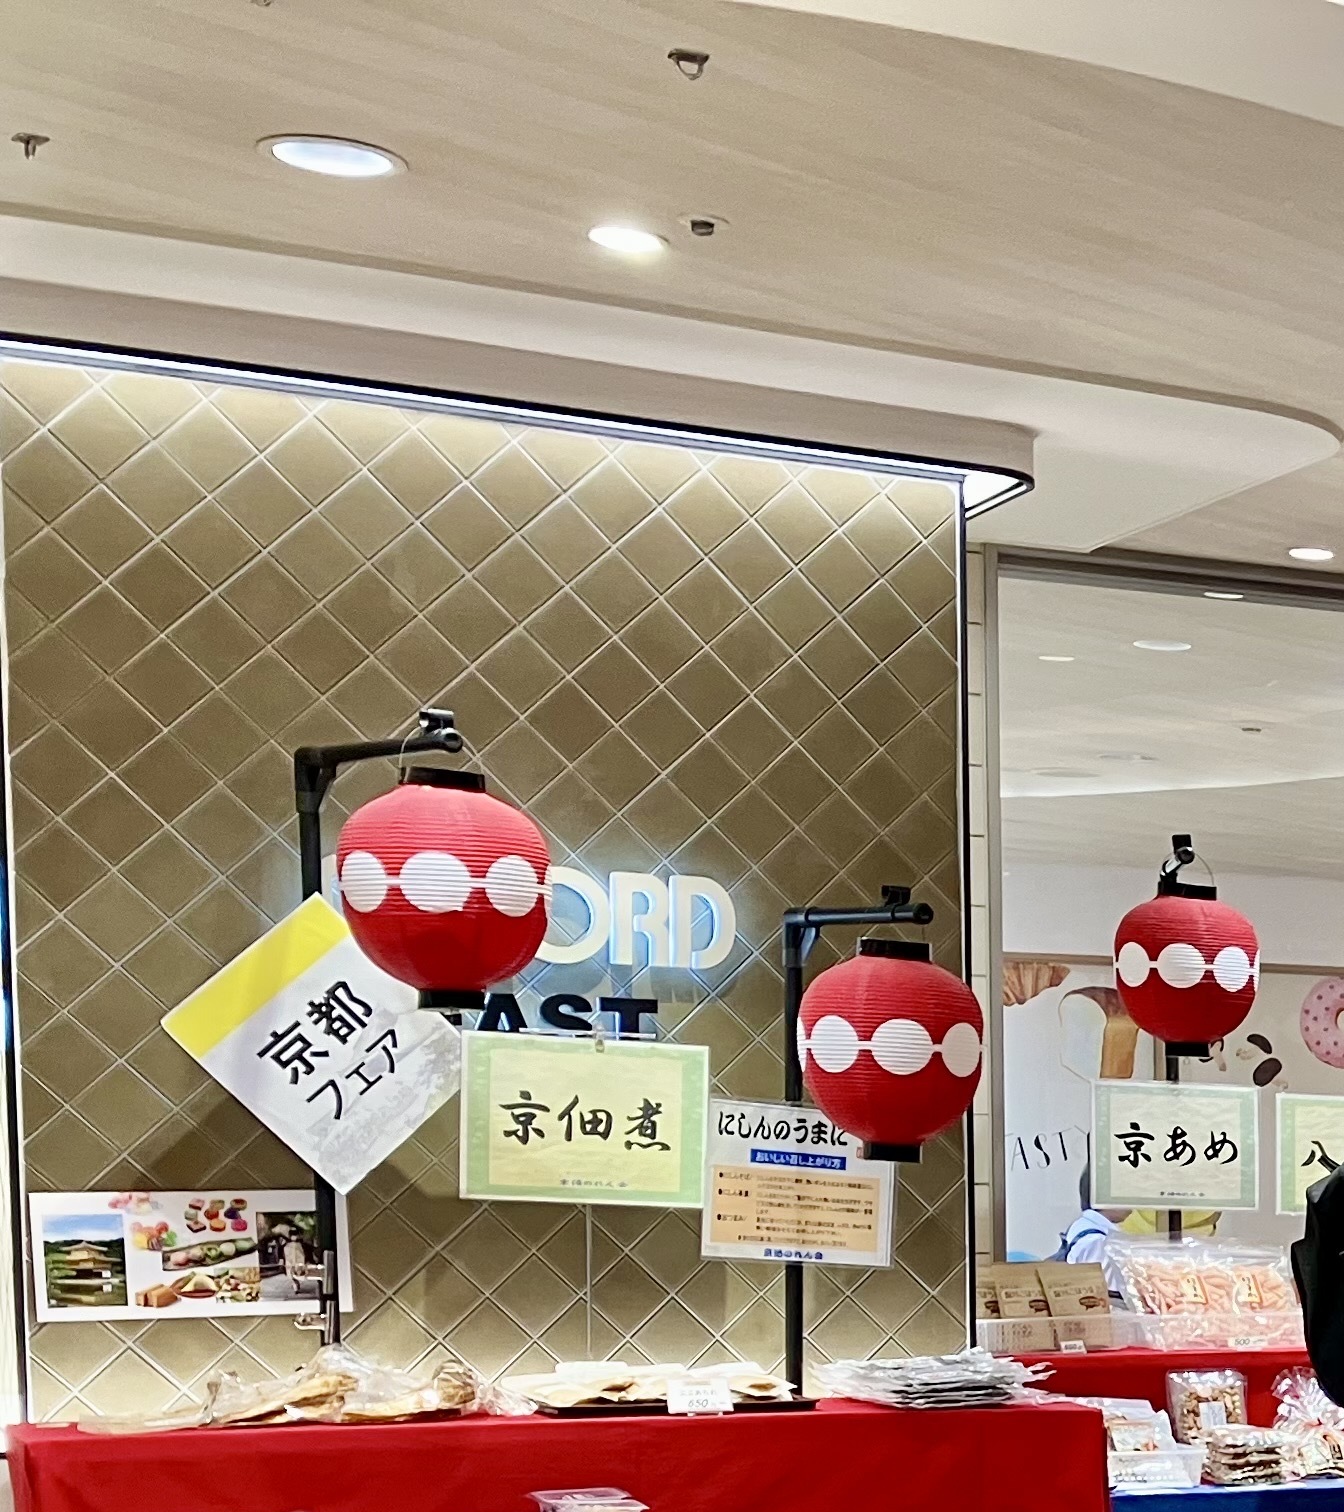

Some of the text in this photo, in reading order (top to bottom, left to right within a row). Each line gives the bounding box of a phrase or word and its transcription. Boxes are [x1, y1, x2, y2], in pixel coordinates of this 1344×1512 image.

[256, 980, 373, 1085] 京都
[446, 993, 659, 1039] AST
[305, 1028, 399, 1121] フェア
[498, 1089, 672, 1152] 京佃煮
[717, 1110, 849, 1147] にしんのうまに
[1113, 1121, 1239, 1169] 京あめ
